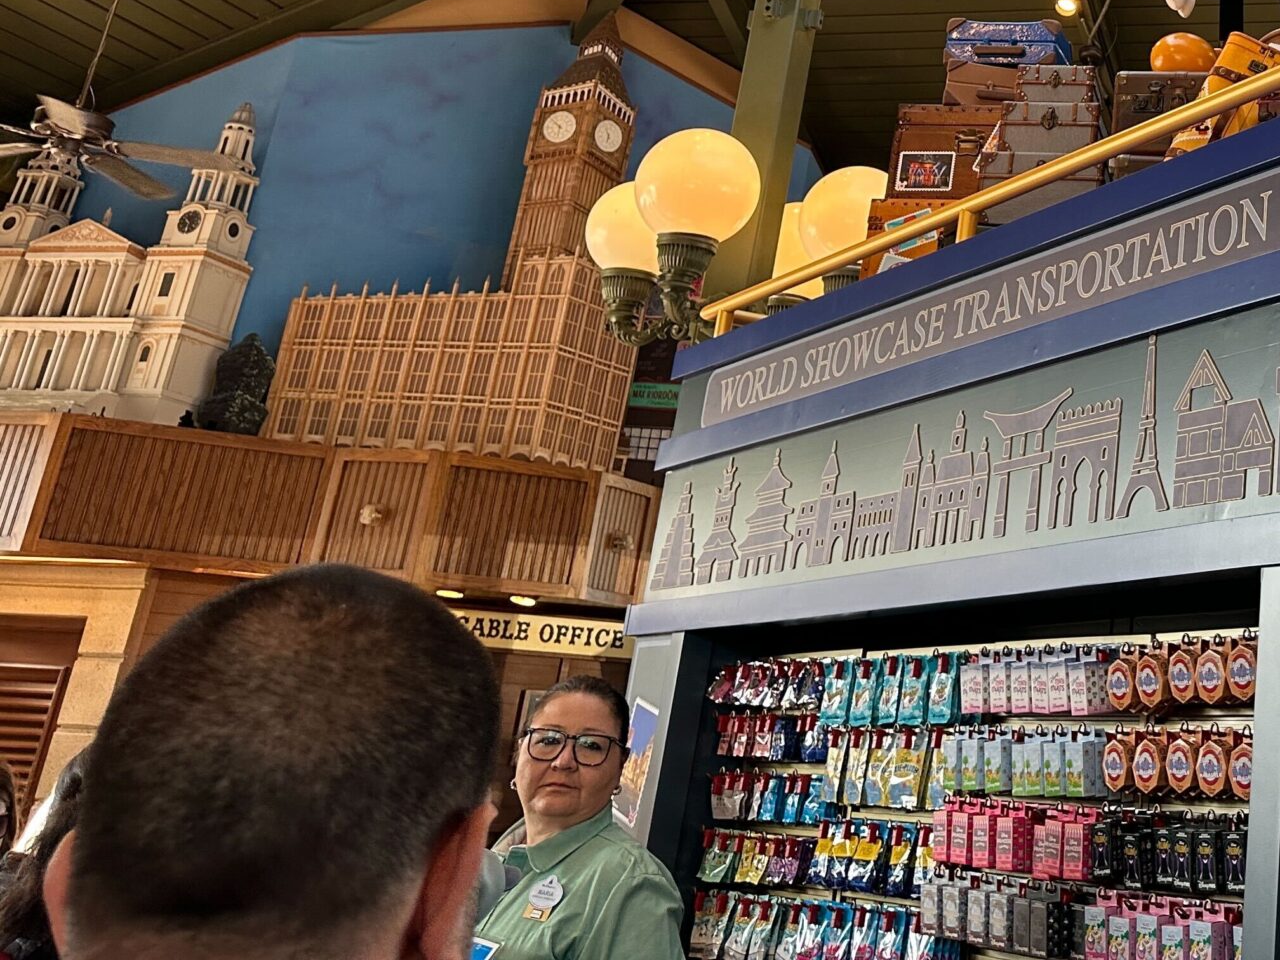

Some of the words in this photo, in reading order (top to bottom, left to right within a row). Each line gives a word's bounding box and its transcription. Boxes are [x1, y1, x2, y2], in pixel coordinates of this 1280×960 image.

[720, 357, 797, 414] WORLD
[800, 302, 946, 387] SHOWCASE
[952, 191, 1274, 336] TRANSPORTATION
[539, 623, 624, 649] OFFICE
